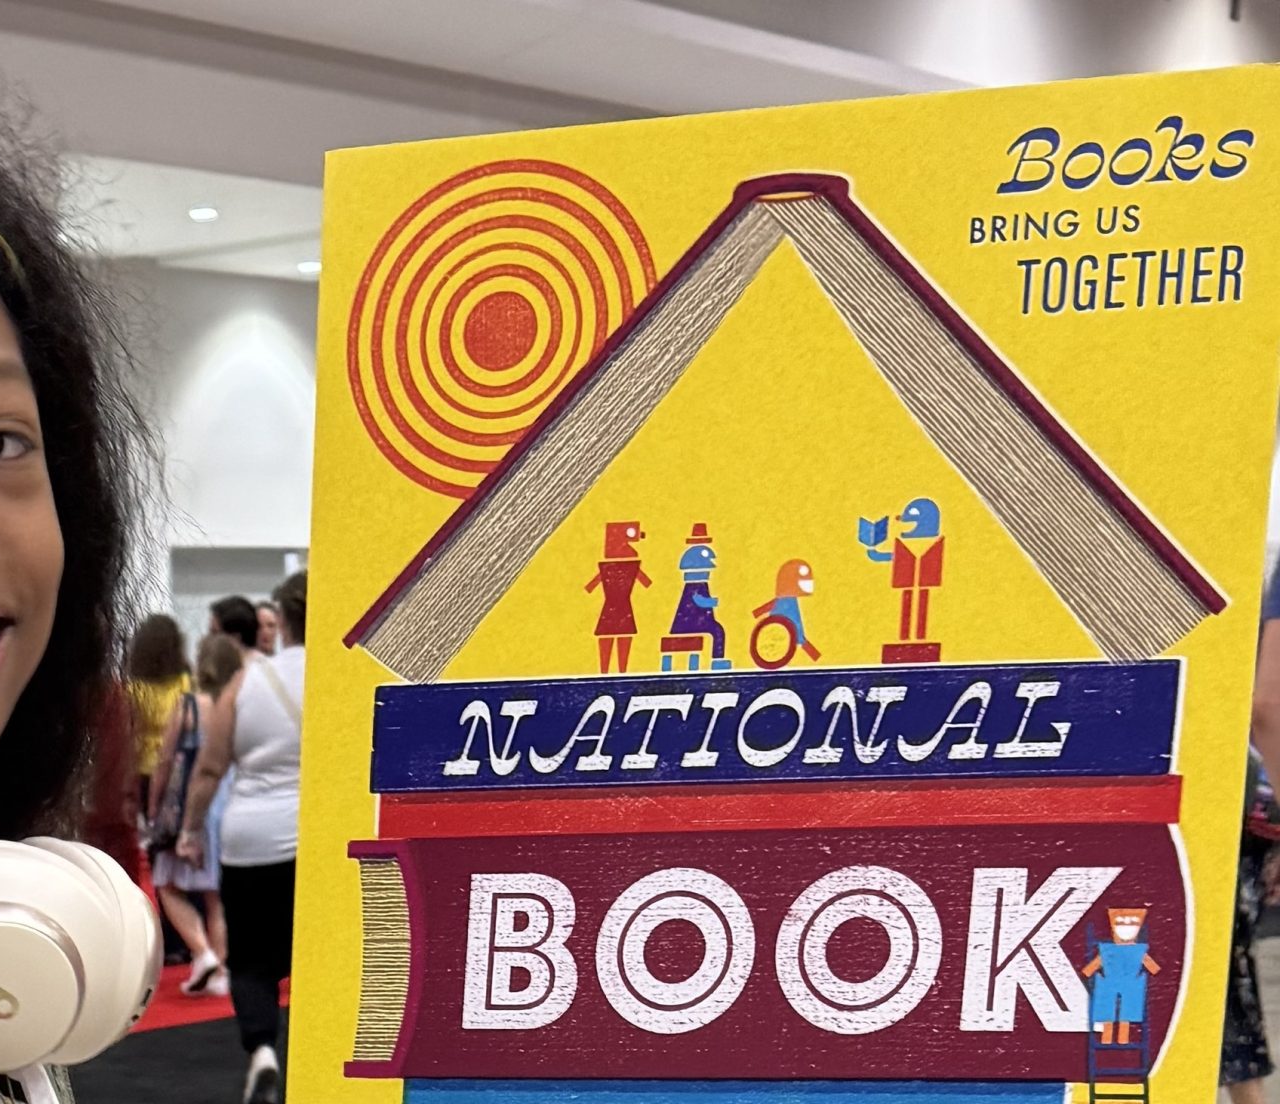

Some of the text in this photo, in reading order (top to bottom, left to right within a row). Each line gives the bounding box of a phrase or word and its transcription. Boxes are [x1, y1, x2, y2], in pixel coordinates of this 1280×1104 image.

[996, 115, 1255, 194] Books
[970, 205, 1140, 244] BRING US
[1017, 245, 1245, 315] TOGETHER
[443, 680, 1073, 777] NATIONAL
[461, 864, 1124, 1036] BOOK
